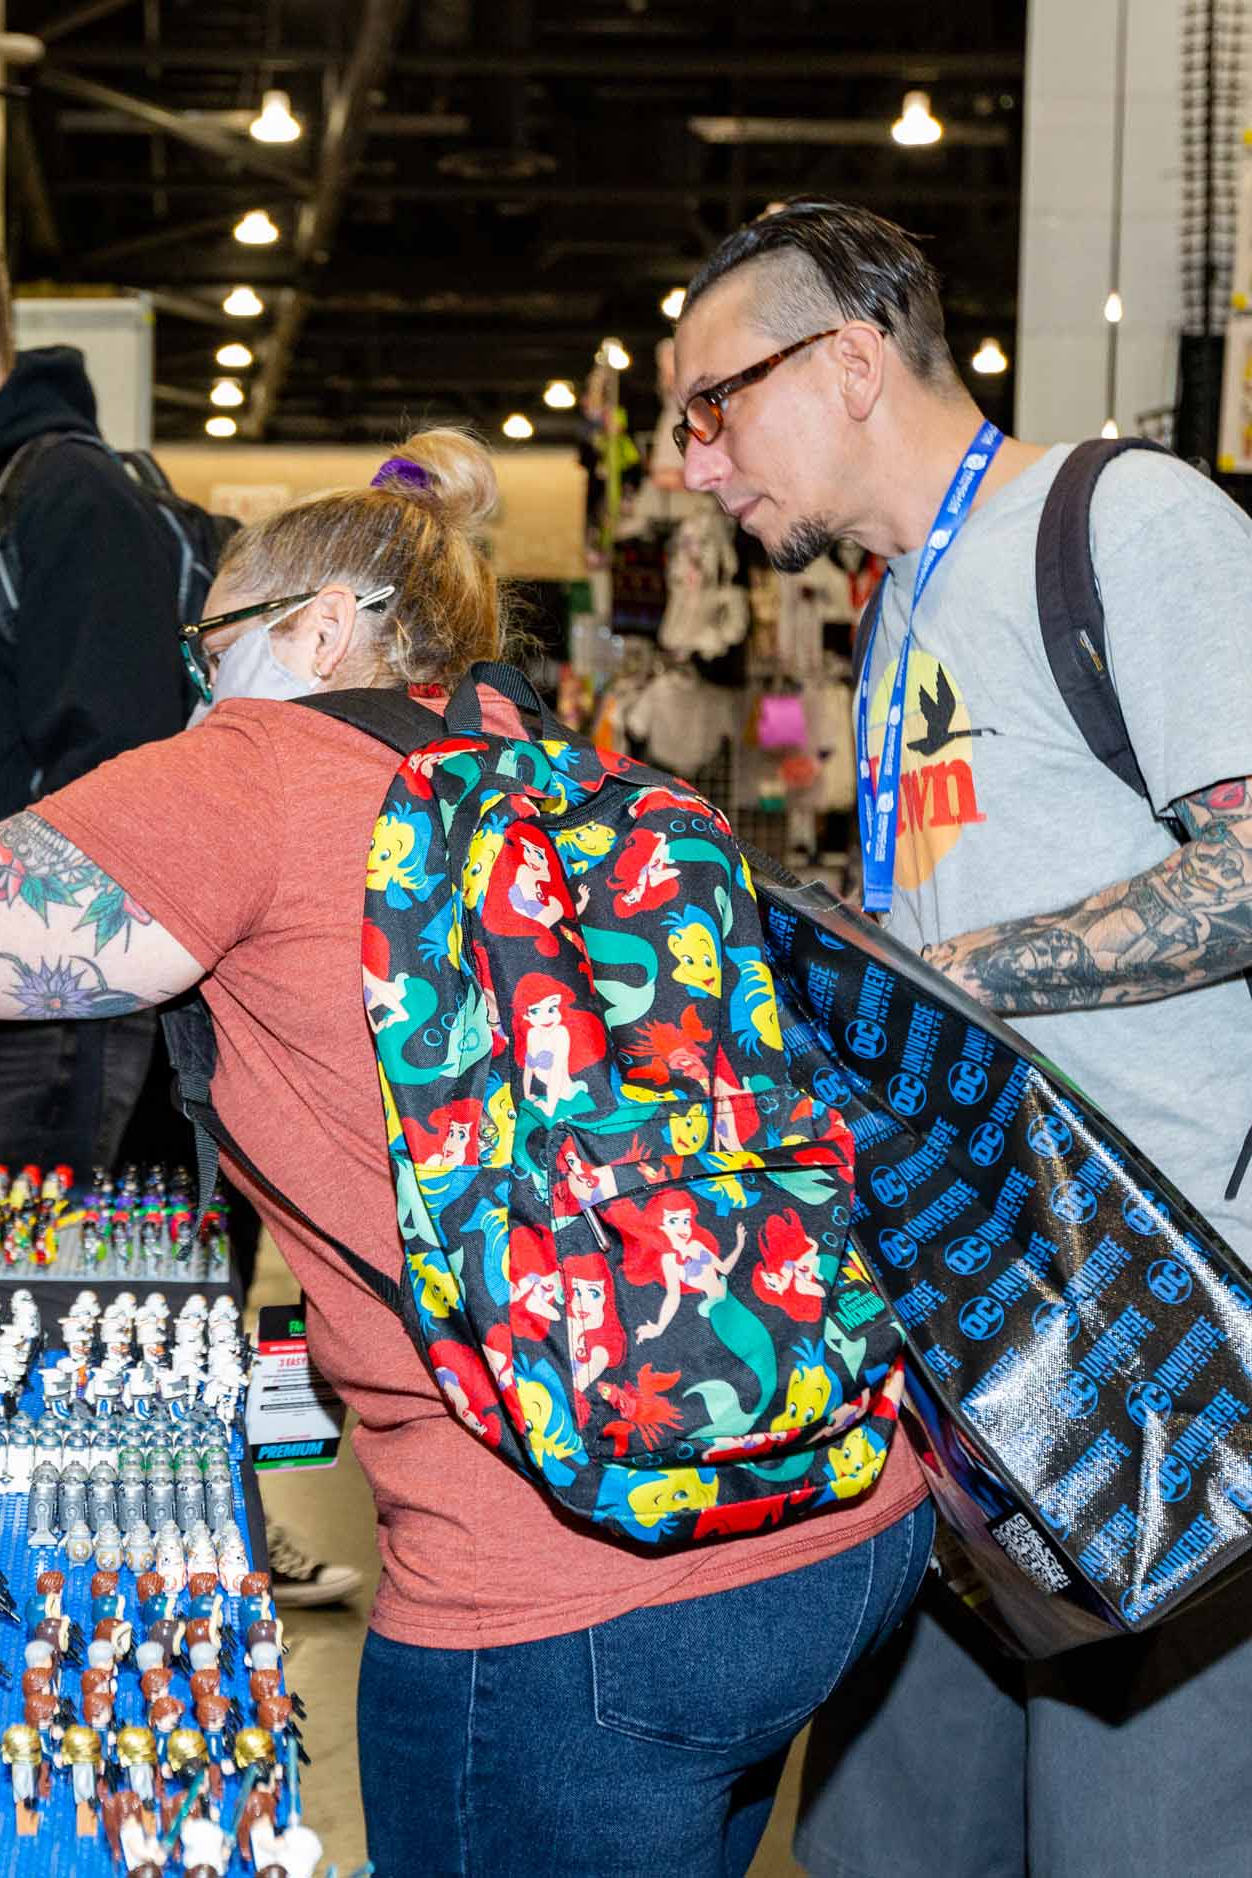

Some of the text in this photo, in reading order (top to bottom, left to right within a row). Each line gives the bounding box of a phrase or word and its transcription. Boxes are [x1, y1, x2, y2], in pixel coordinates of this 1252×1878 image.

[856, 961, 888, 1021] UNIVER
[877, 974, 897, 1025] INFINI
[899, 1001, 936, 1075] UNIVERSE
[895, 1115, 949, 1182] UNIVERSE
[901, 1177, 974, 1240] UNIVERSE
[974, 1166, 1029, 1242] UNIVERSE
[1078, 1304, 1144, 1381] UNIVERSE
[1153, 1315, 1215, 1391] UNIVERSE
[257, 1440, 325, 1461] PREMIUM
[1172, 1386, 1242, 1463] UNIVERSE
[1147, 1512, 1216, 1584] UNIVERSE
